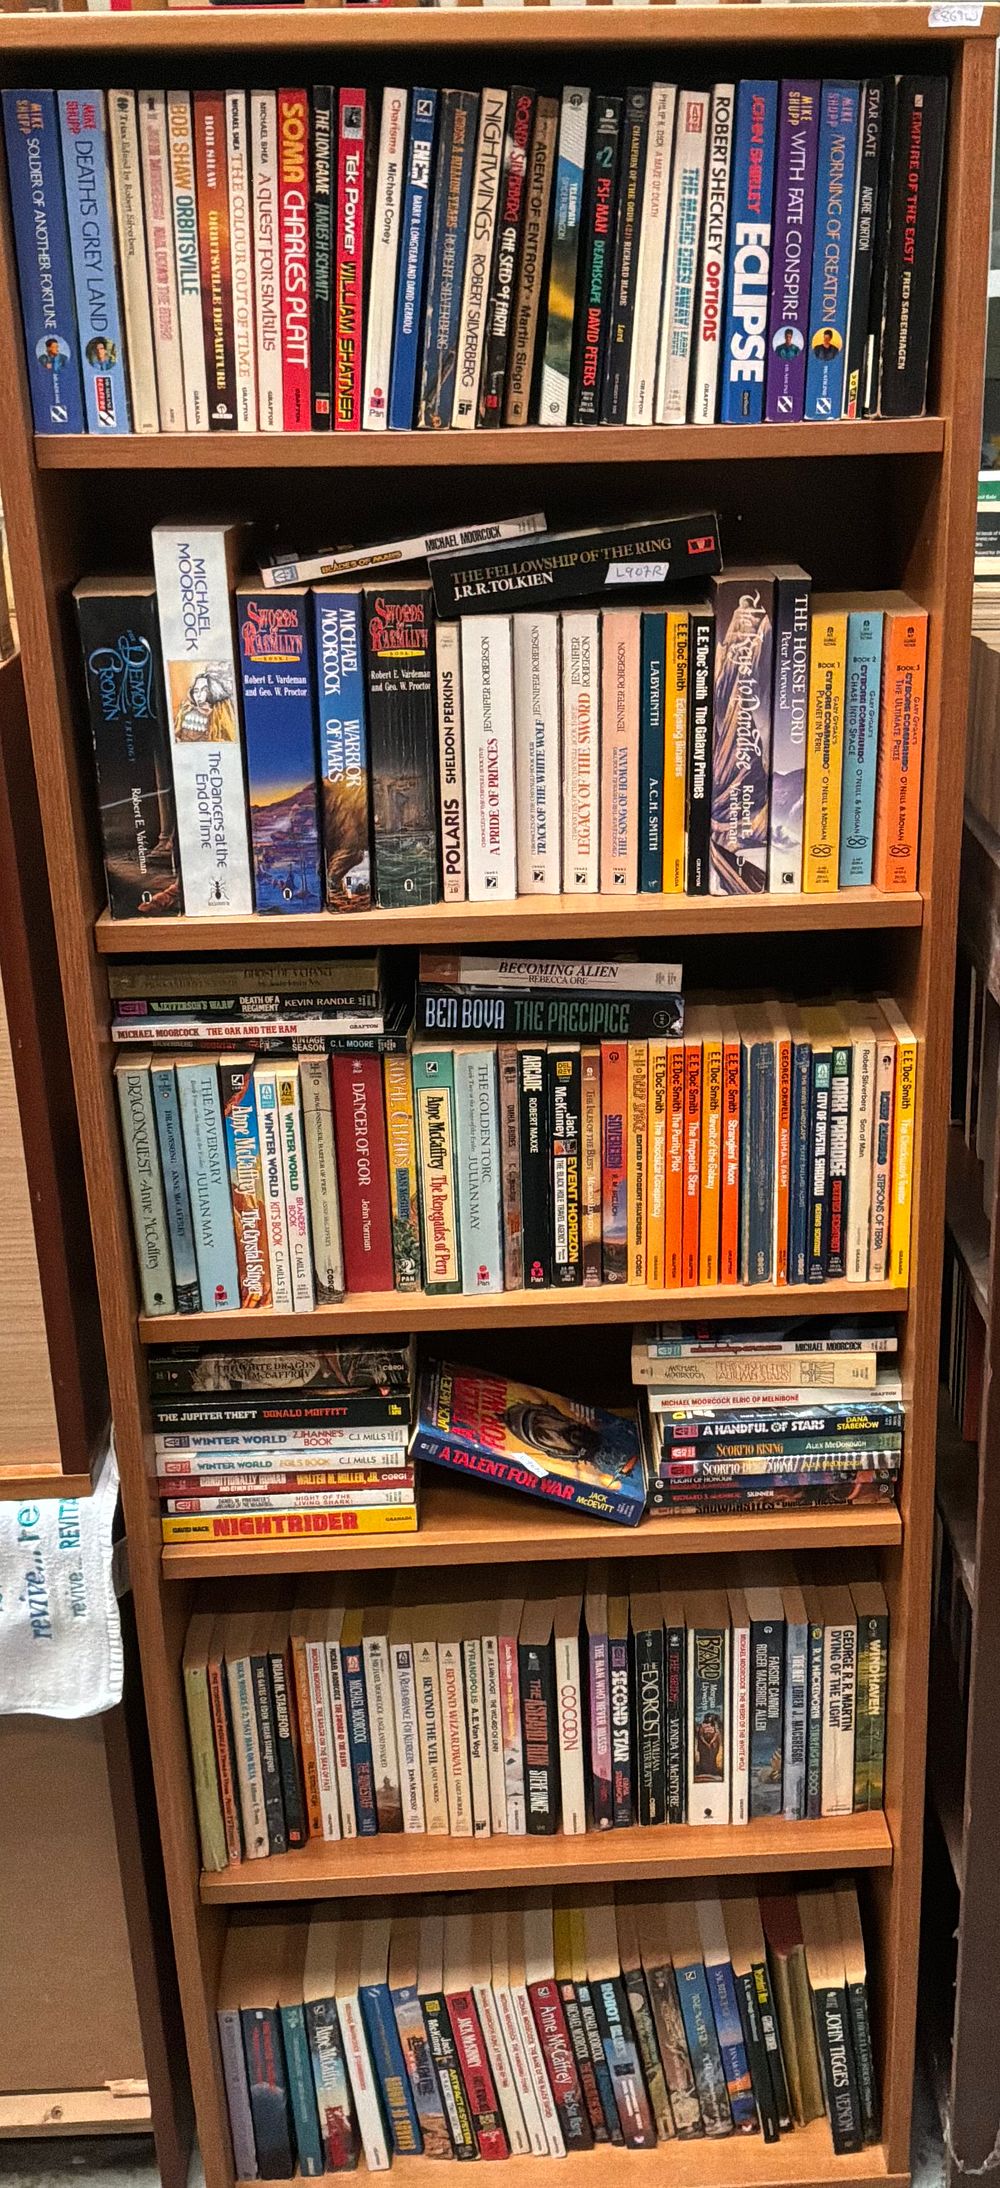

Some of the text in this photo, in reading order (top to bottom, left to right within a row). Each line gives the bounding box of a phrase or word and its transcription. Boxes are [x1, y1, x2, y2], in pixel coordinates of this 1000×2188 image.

[788, 91, 812, 126] MIKE SHUPP
[170, 104, 198, 296] BOB SHAW ORBITSVILLE
[382, 100, 401, 245] Charisma Michael Coney
[859, 88, 880, 251] STAR GATE ANDRE NORTON
[27, 138, 56, 329] SOLDIER OF ANOTHER FORTUNE
[75, 140, 108, 332] DEATH'S GREY LAND
[282, 102, 308, 368] SOMA CHARLES PLATT
[462, 99, 503, 387] NIGHTWINGS ROBERT SILVERBERG
[702, 96, 730, 342] ROBERT SHECKLEY OPTIONS
[783, 131, 806, 321] WITH FATE CONSPIRE
[898, 111, 923, 370] EMPIRE OF THE EAST FRED SABERHAGEN
[338, 151, 360, 421] Tek Power WILLIAM SHATNER
[582, 178, 611, 387] PSI-MAN DEATHSCAPE DAVID PETERS
[729, 222, 771, 383] ECLIPSE
[425, 526, 502, 550] MICHAEL MOORCOCK
[452, 538, 672, 584] THE FELLOWSHIP OF THE RING
[176, 543, 198, 652] MOORCOCK
[193, 558, 211, 635] MICHAEL
[320, 608, 341, 696] MOORCOCK
[340, 608, 357, 677] MICHAEL
[778, 632, 788, 710] Peter Morwood
[790, 594, 808, 745] THE HORSE LORD
[326, 719, 344, 784] OF MARS
[343, 719, 362, 788] WARRIOR
[442, 671, 460, 874] POLARIS SHELDON PERKINS
[481, 636, 500, 856] A PRIDE OF PRINCES JENNIFER ROBERSON
[649, 661, 660, 851] LABYRINTH A.C.H. SMITH
[195, 773, 211, 849] End of Time
[208, 752, 227, 868] The Dancers at the
[284, 997, 354, 1007] KEVIN RANDLE
[499, 961, 619, 978] BECOMING ALIEN
[528, 974, 588, 984] REBECCA ORE
[118, 1029, 154, 1039] MICHAEL
[156, 1028, 200, 1038] MOORCOCK
[206, 1028, 222, 1036] THE
[224, 1026, 240, 1035] OAK
[242, 1026, 259, 1034] AND
[260, 1026, 276, 1034] THE
[278, 1025, 297, 1034] RAM
[292, 1036, 324, 1044] VINTAGE
[292, 1043, 325, 1052] SEASON
[346, 1040, 374, 1048] MOORE
[425, 998, 630, 1033] BEN BOVA THE PRECIPICE
[522, 1054, 542, 1153] ARCADE ROBERT MAXXE
[352, 1083, 370, 1251] DANCER OF GOR John Norman
[566, 1157, 579, 1263] EVENT HORIZON
[795, 1342, 862, 1351] MICHAEL MOORCOCK
[158, 1410, 257, 1421] THE JUPITER THEFT
[192, 1434, 287, 1445] WINTER WORLD
[703, 1420, 825, 1436] A HANDFUL OF STARS
[836, 1421, 879, 1430] STABENOW
[845, 1416, 868, 1424] DANA
[381, 1473, 407, 1481] CORGI
[438, 1447, 575, 1500] A TALENT FOR WAR
[576, 1496, 614, 1514] McDEVITT
[589, 1491, 608, 1503] JACK
[212, 1512, 359, 1536] NIGHTRIDER
[829, 1630, 841, 1728] DYING OF THE LIGHT
[843, 1630, 854, 1670] GEORGE
[868, 1640, 882, 1716] WINDHAVEN
[560, 1685, 579, 1751] COCOON
[611, 1670, 629, 1763] SECOND STAR
[841, 1693, 853, 1731] MARTIN
[540, 2006, 557, 2033] Anne
[826, 2013, 849, 2088] JOHN TIGGES
